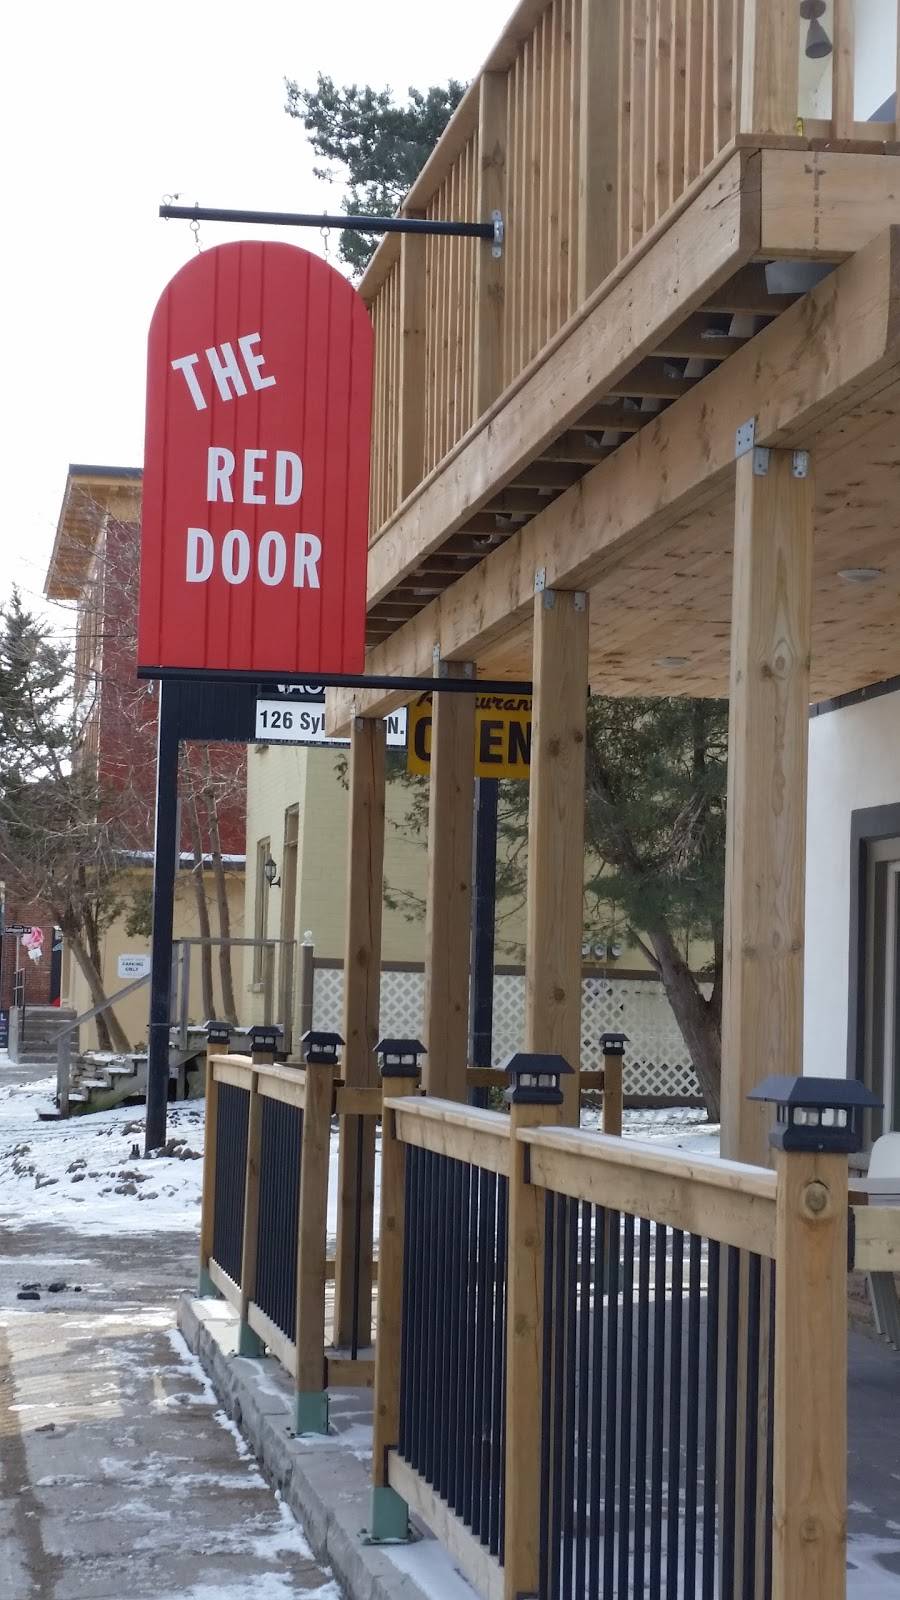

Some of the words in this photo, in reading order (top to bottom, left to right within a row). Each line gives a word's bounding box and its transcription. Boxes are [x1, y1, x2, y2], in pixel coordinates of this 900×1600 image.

[171, 332, 276, 411] THE
[207, 446, 303, 506] RED
[186, 527, 322, 589] DOOR
[260, 710, 293, 729] 126
[300, 712, 325, 735] Syl
[388, 716, 404, 735] N.
[414, 716, 532, 765] OEN
